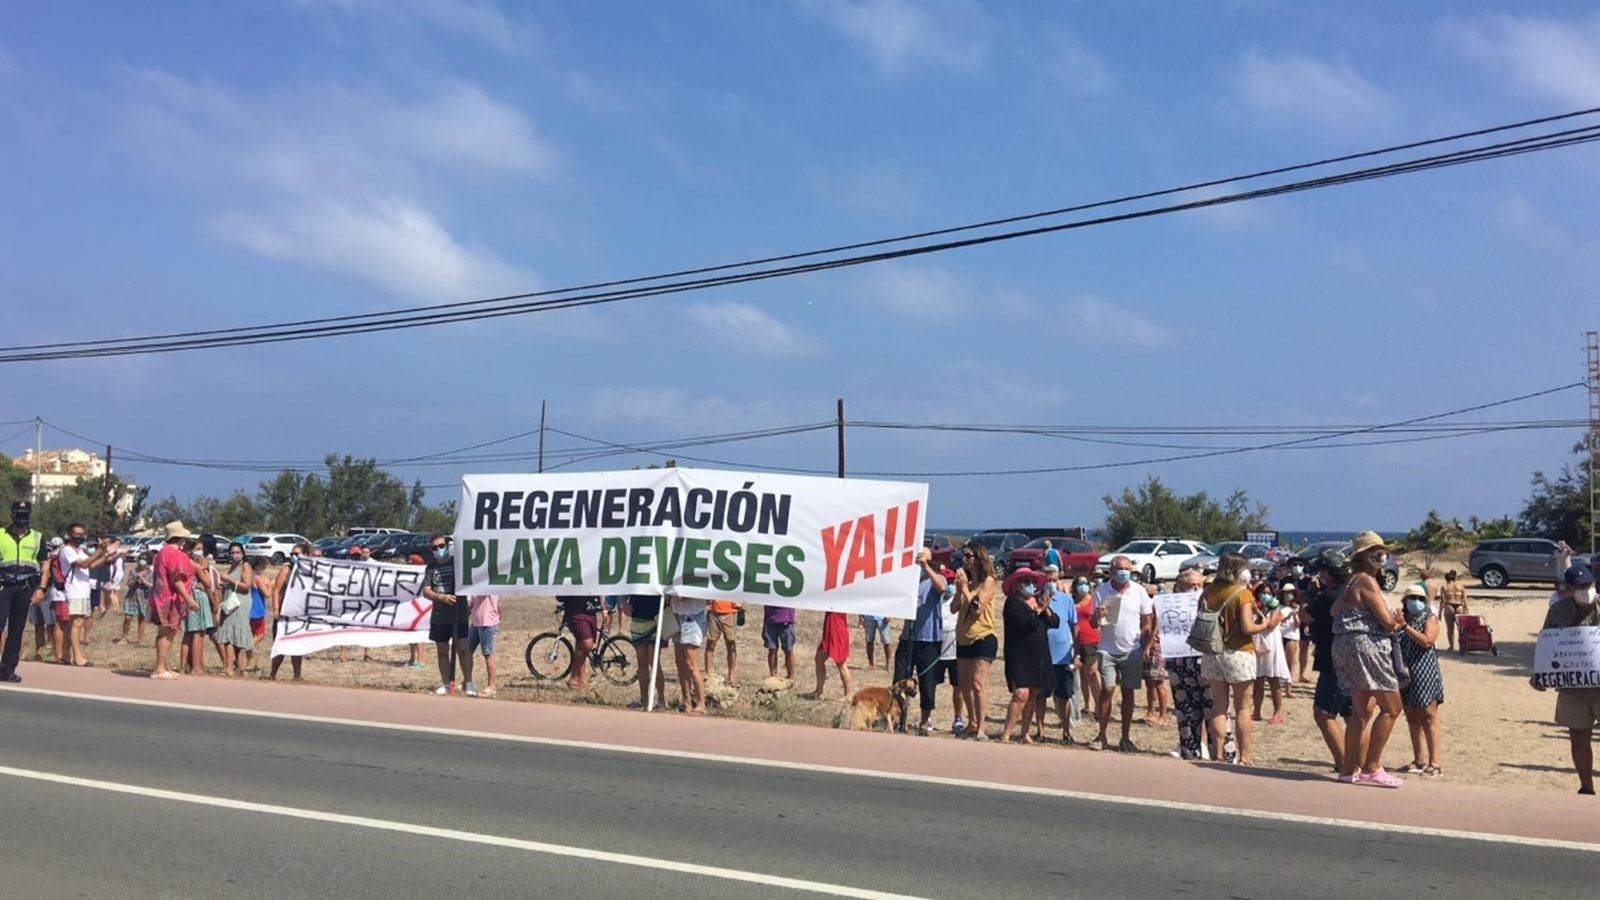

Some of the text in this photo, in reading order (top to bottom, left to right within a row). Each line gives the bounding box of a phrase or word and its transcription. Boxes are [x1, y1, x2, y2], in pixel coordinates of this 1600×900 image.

[474, 481, 792, 535] REGENERACIÓN
[462, 535, 806, 598] PLAYA DEVESES
[820, 499, 920, 592] YA!!
[305, 592, 401, 627] PLAYA
